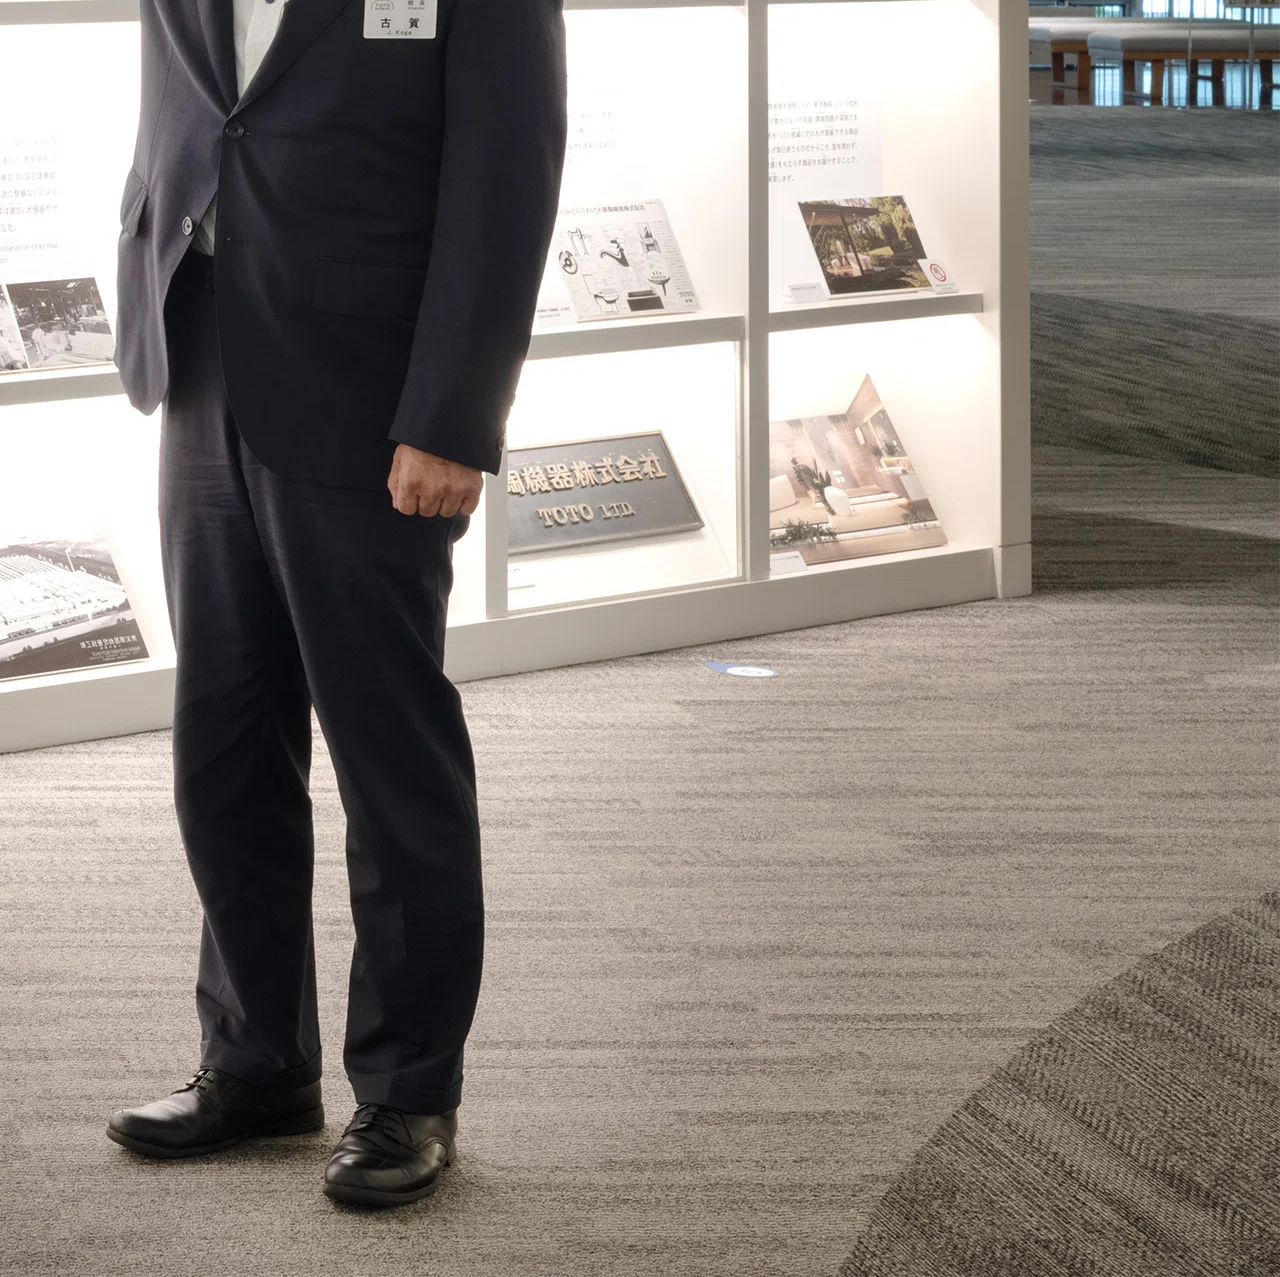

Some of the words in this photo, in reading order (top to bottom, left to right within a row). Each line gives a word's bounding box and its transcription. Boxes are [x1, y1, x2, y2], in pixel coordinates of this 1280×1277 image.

[380, 17, 420, 29] 古賀
[535, 503, 595, 528] TOTO
[598, 500, 637, 519] LTD.
